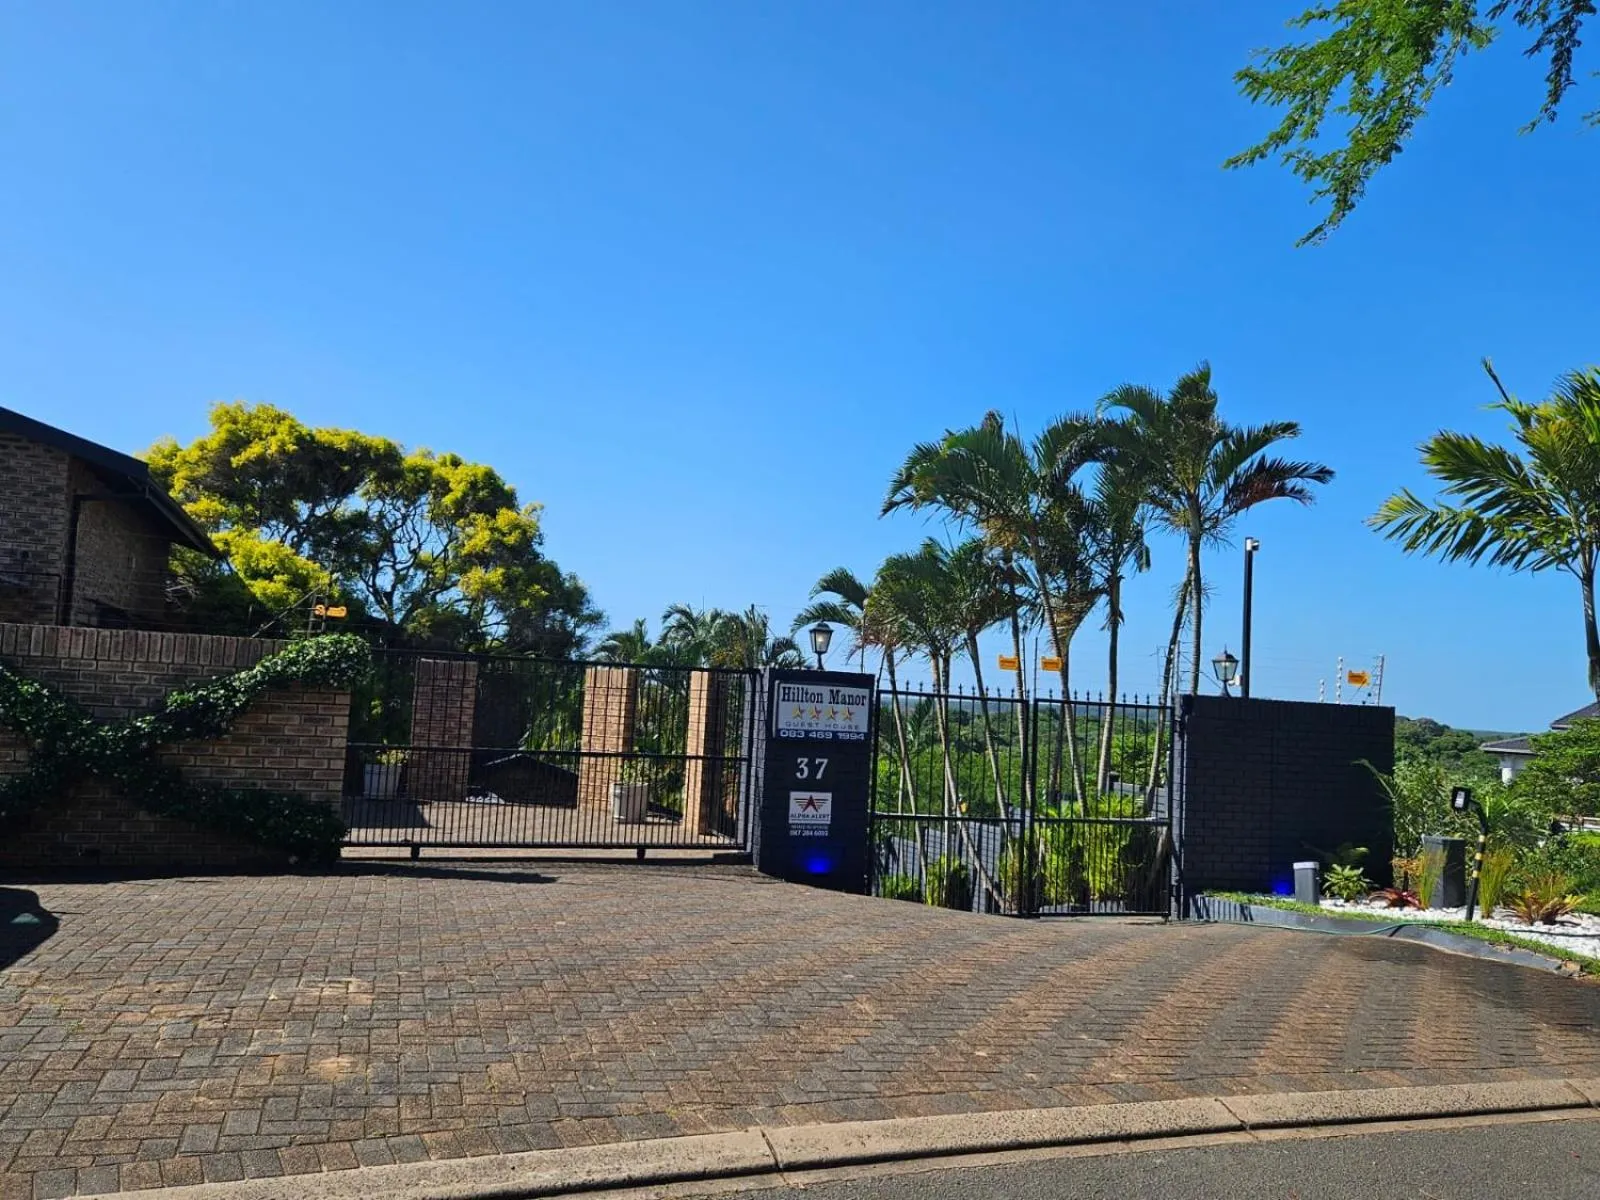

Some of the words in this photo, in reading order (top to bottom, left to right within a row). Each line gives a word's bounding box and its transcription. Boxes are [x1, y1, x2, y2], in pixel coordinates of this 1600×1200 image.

[781, 686, 824, 704] Hillton
[828, 688, 867, 706] Manor
[785, 721, 820, 729] GUEST
[825, 723, 860, 731] HOUSE
[780, 730, 805, 738] 083
[837, 733, 865, 741] 1994
[795, 757, 829, 780] 37
